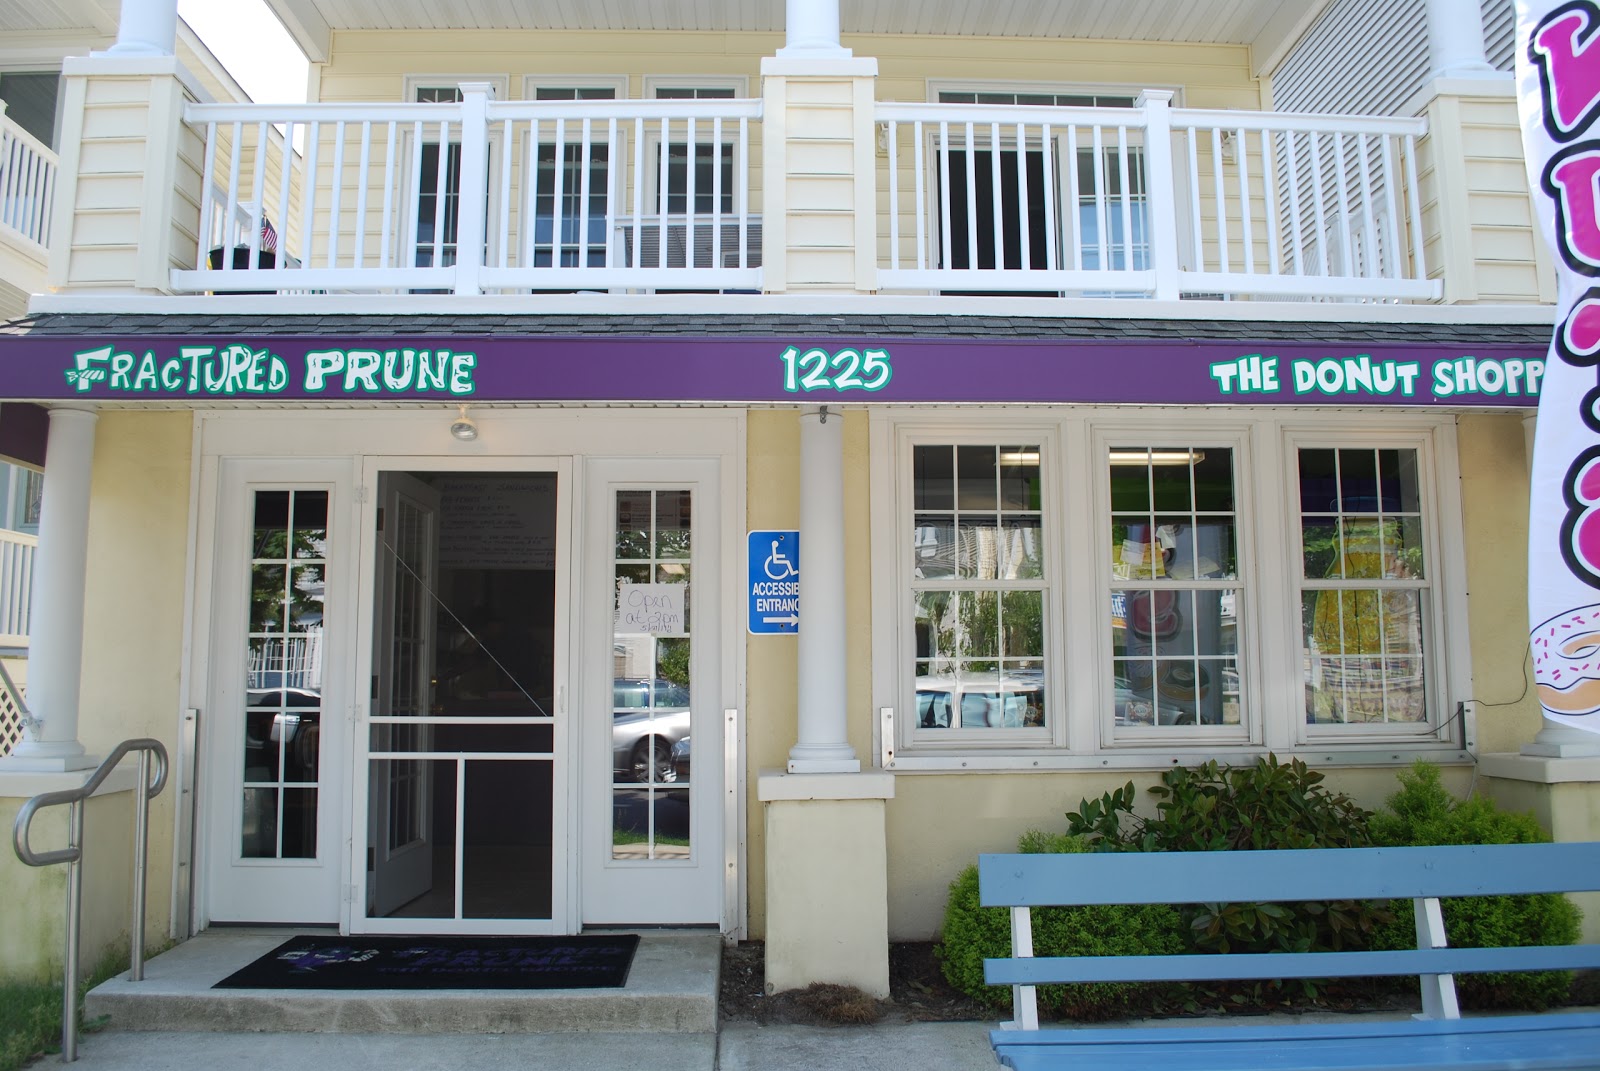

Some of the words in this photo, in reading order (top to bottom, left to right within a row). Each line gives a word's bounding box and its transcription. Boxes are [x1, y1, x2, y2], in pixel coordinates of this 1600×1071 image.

[65, 343, 290, 395] FRACTURED
[304, 348, 477, 396] PRUNE
[780, 346, 893, 393] 1225
[1209, 353, 1280, 395] THE
[1290, 353, 1420, 397] DONUT
[1431, 356, 1545, 398] SHOPP
[628, 589, 672, 613] Open
[752, 582, 799, 596] ACCESSIB
[756, 598, 799, 612] ENTRANC
[626, 610, 646, 625] at
[647, 611, 679, 631] 2pm
